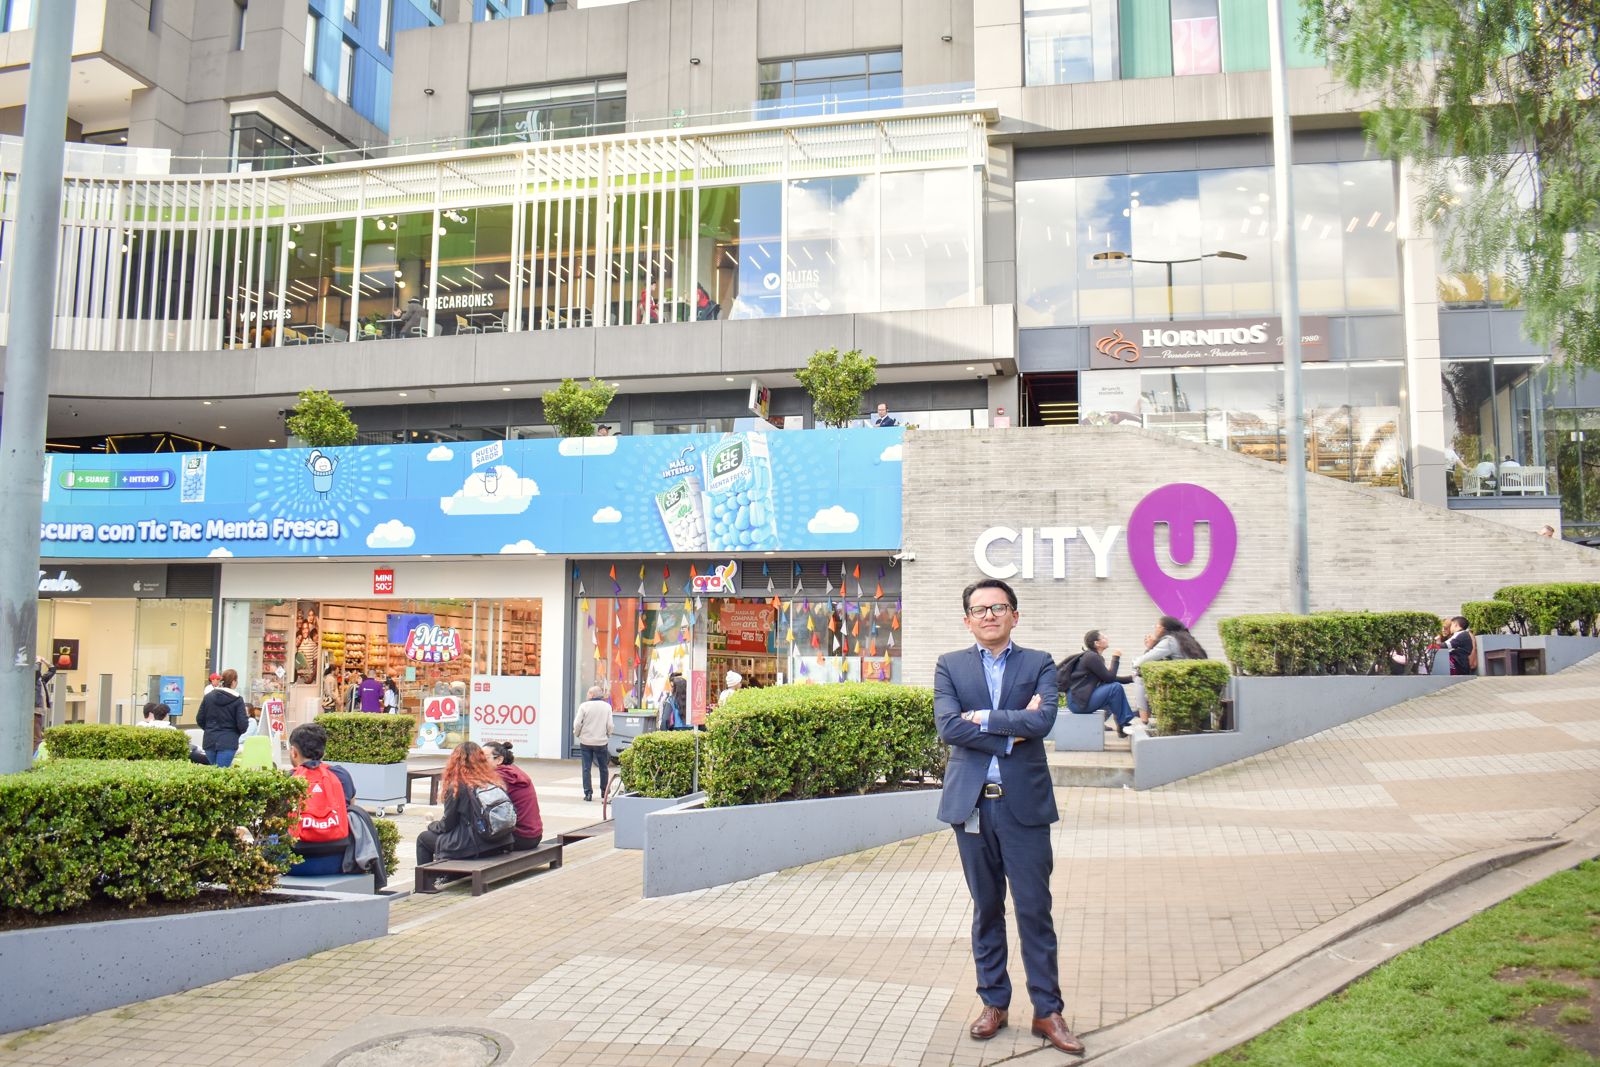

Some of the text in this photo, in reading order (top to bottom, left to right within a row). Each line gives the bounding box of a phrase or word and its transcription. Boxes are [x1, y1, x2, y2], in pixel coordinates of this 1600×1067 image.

[787, 270, 819, 283] ALITAS
[1142, 324, 1267, 348] HORNITOS
[1301, 334, 1319, 343] 1980
[475, 444, 499, 458] NUEVO
[476, 450, 499, 464] SABOR
[719, 447, 740, 462] tic
[662, 464, 695, 478] INTENSO
[669, 459, 686, 469] MÁS
[716, 457, 739, 473] tac
[129, 475, 159, 483] INTENSO
[710, 468, 752, 490] MENTA FRESCA
[97, 524, 135, 541] con
[137, 519, 167, 540] Tic
[169, 520, 202, 540] Tac
[205, 519, 269, 540] Menta
[272, 518, 340, 539] Fresca
[973, 520, 1211, 580] CITY U
[375, 574, 392, 582] MINI
[693, 576, 721, 588] ara
[413, 624, 455, 647] Mid
[407, 648, 459, 661] SEASON
[425, 697, 456, 721] 40
[474, 704, 537, 726] $8.900
[272, 721, 284, 732] 40
